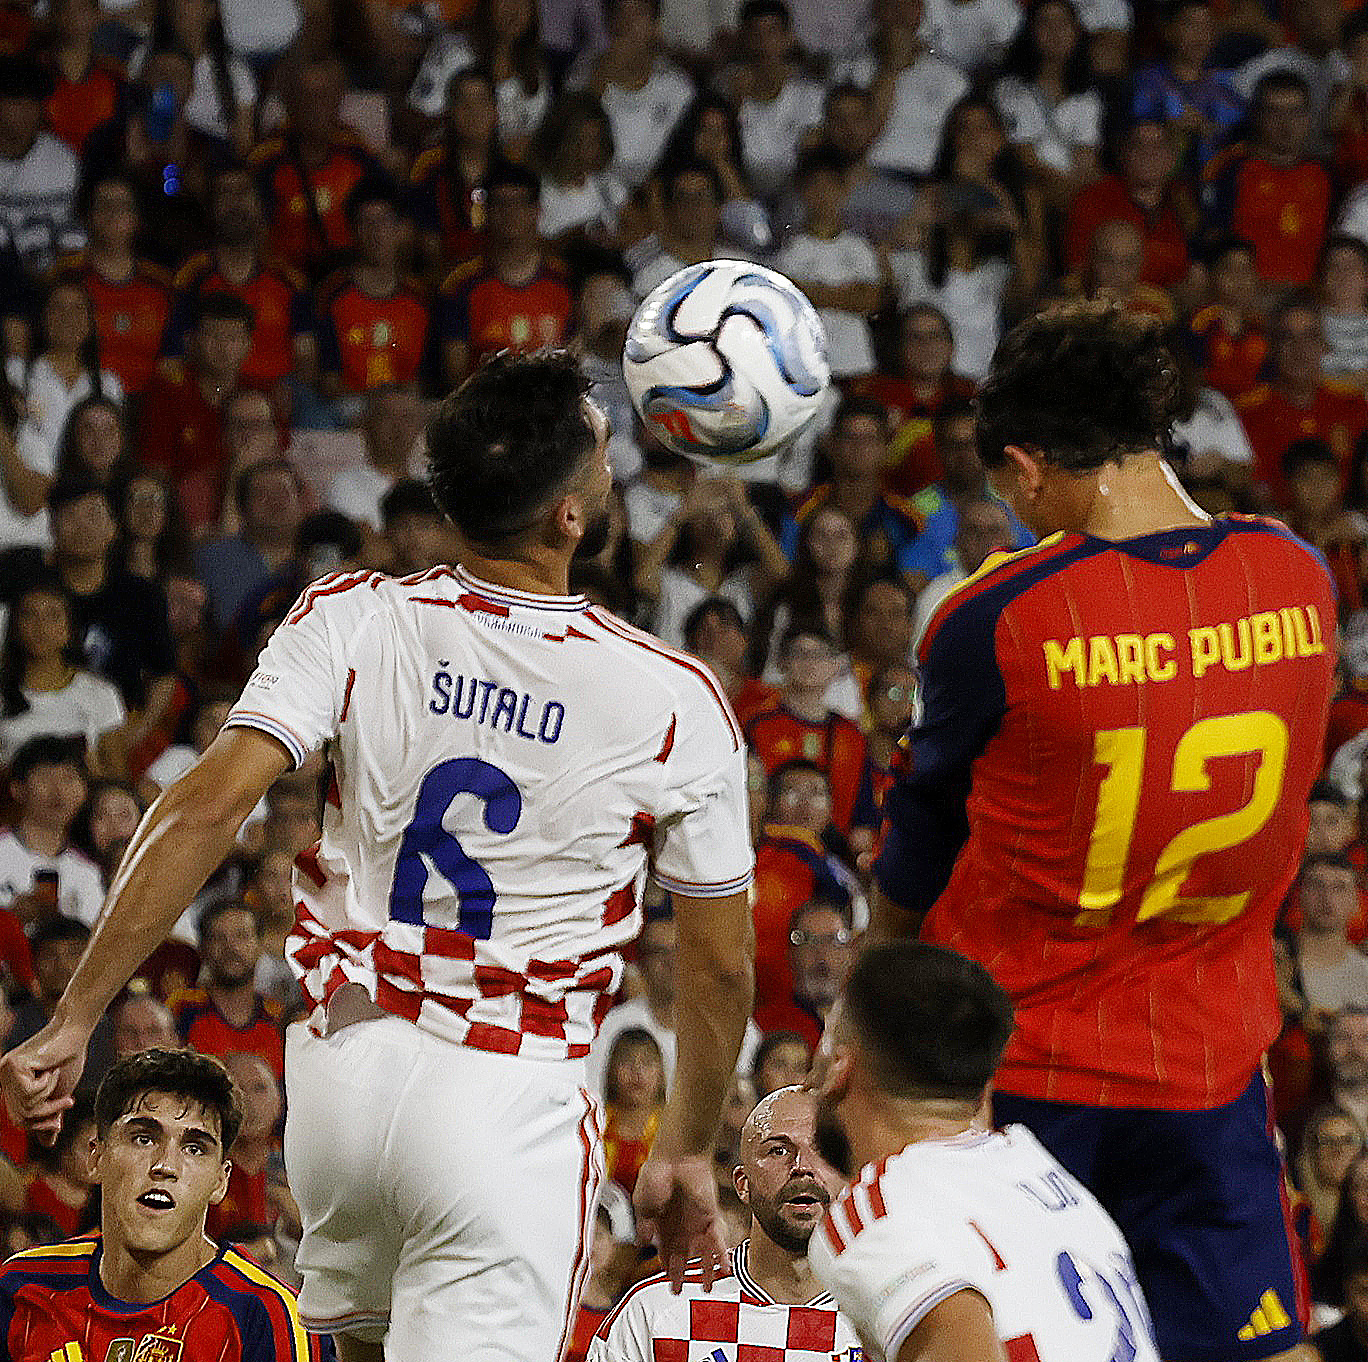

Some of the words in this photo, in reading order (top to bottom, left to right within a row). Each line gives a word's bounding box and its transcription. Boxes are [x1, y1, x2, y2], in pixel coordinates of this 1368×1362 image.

[428, 657, 565, 744] ŠUTALO
[1042, 631, 1179, 690] MARC
[388, 756, 523, 942] 6
[1075, 709, 1288, 926] 12
